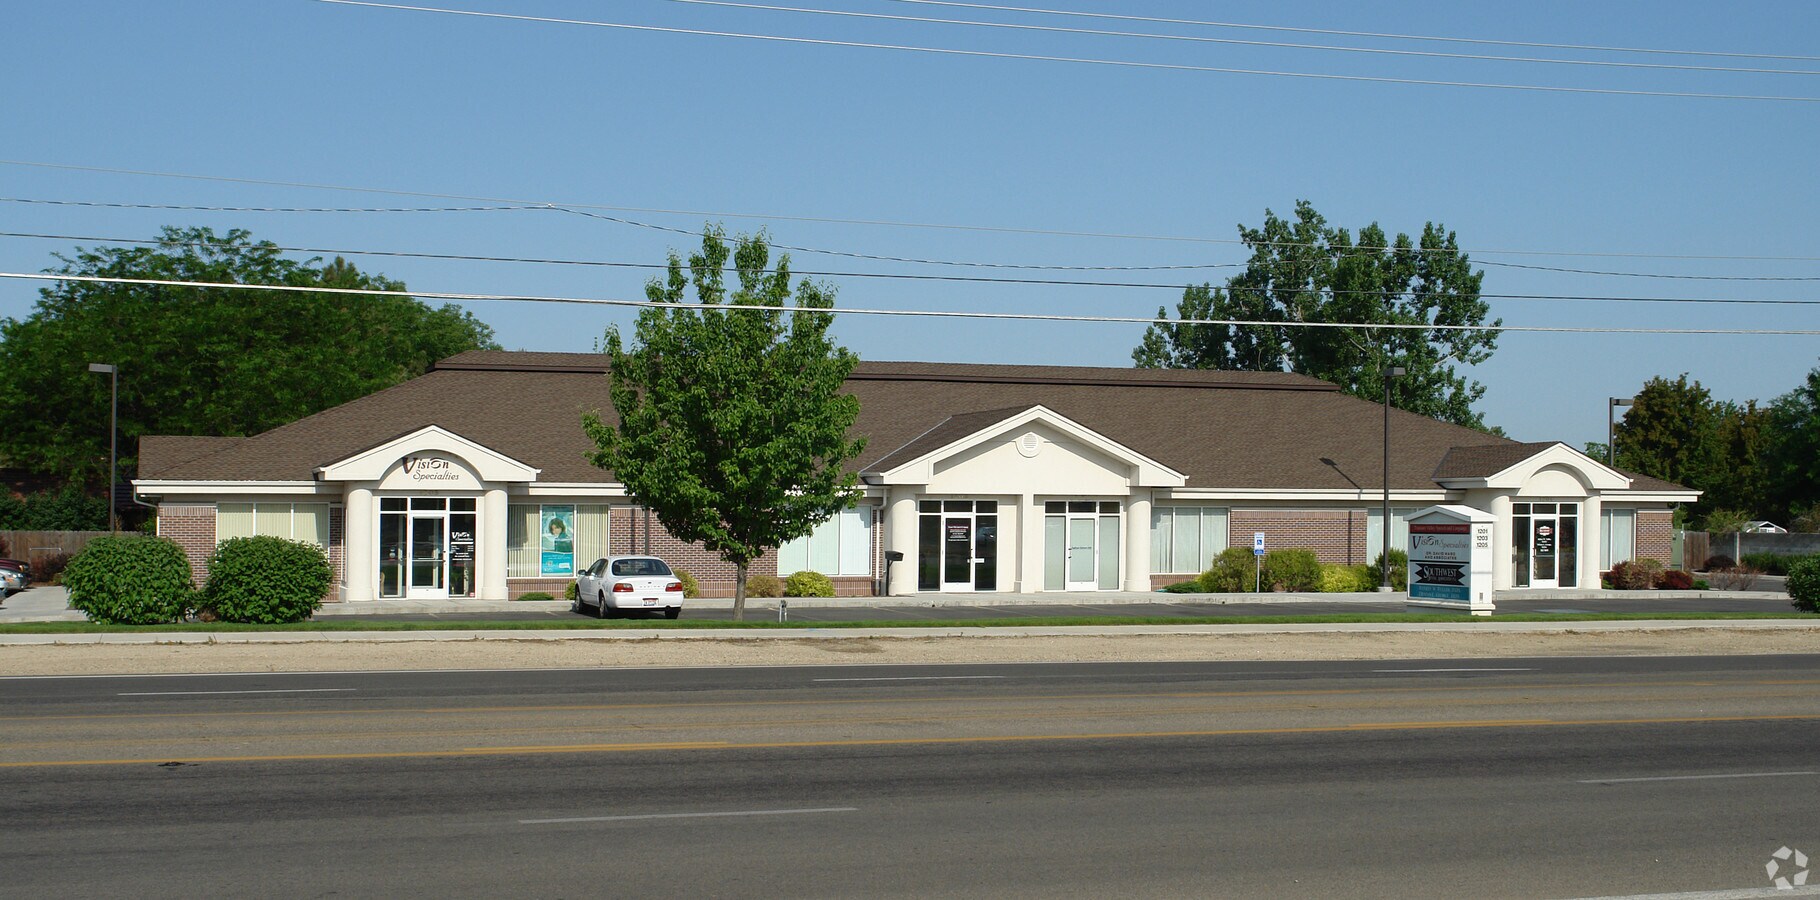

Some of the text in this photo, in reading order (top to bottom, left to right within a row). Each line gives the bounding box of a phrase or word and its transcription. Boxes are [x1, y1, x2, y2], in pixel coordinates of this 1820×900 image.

[402, 457, 449, 474] Vision
[412, 470, 459, 482] Specialties
[1412, 535, 1439, 549] Vision
